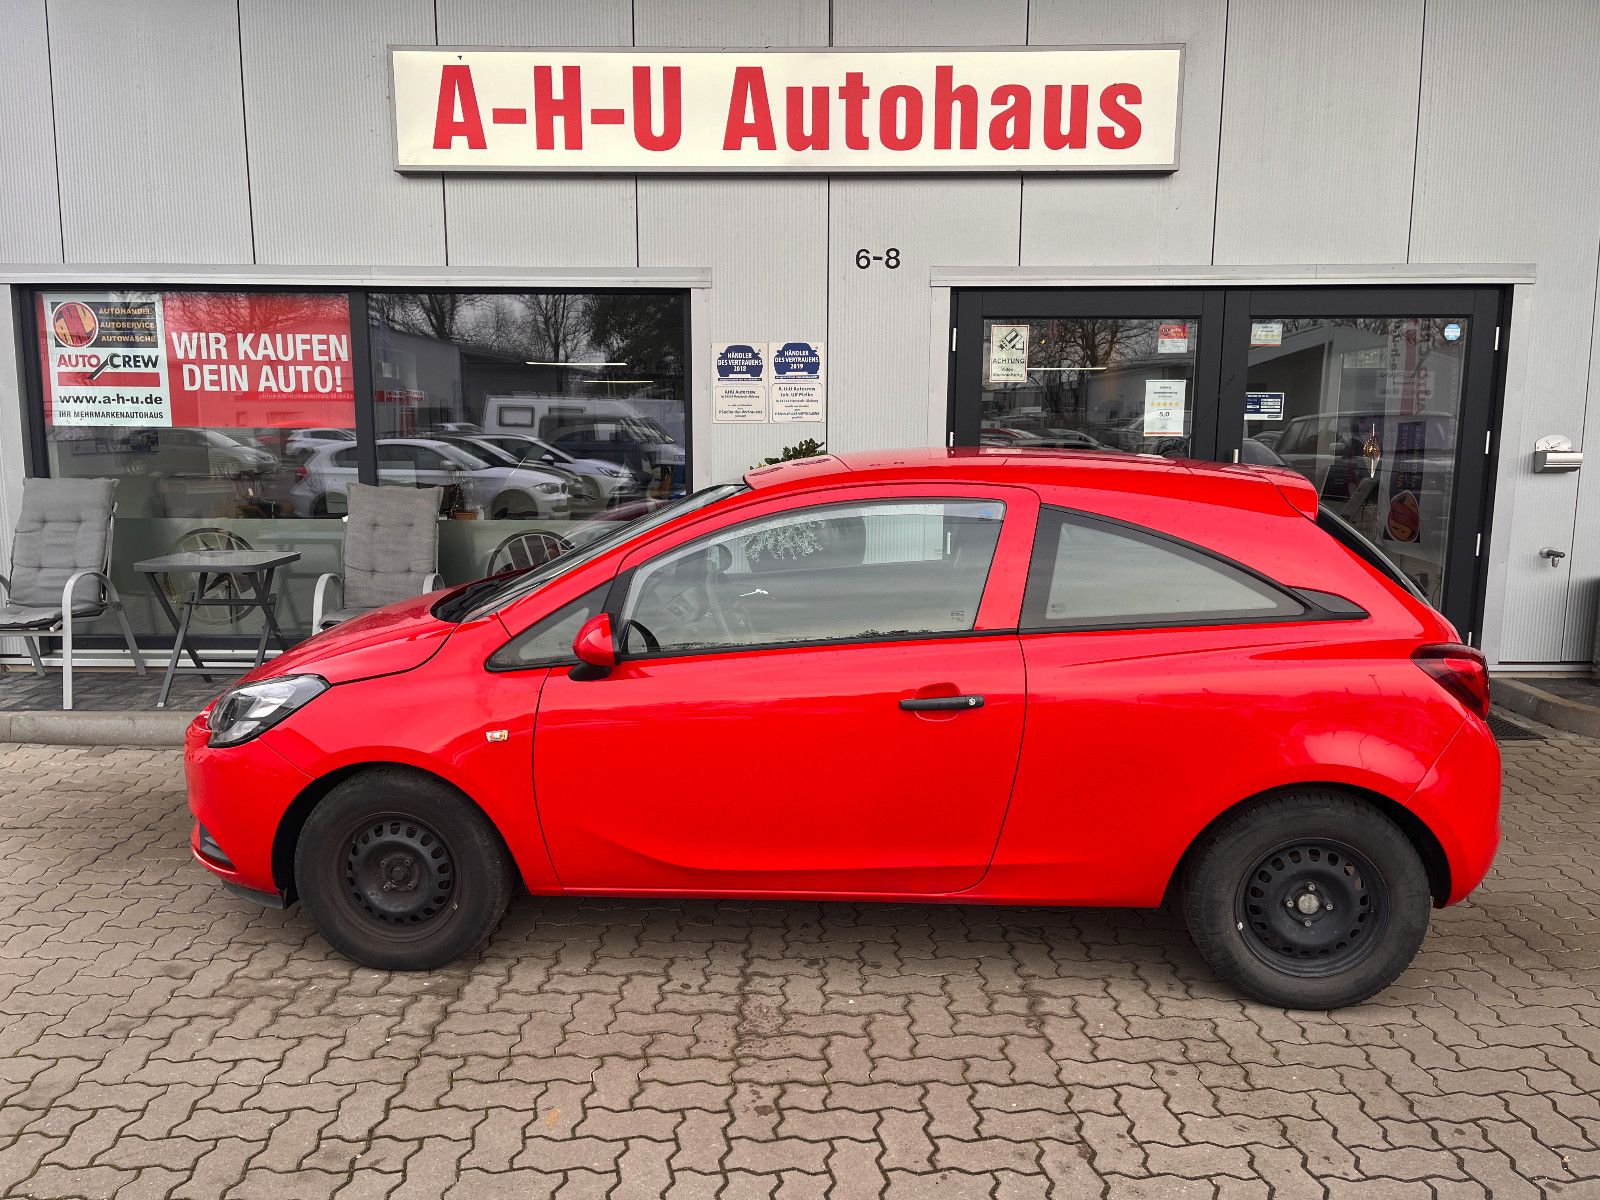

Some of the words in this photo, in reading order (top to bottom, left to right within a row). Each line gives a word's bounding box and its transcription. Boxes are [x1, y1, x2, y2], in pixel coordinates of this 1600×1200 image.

[432, 65, 682, 152] A-H-U
[723, 65, 1143, 152] Autohaus
[855, 247, 901, 270] 6-8
[99, 307, 153, 315] AUTOHANDEL
[100, 321, 156, 329] AUTOSERVICE
[171, 332, 228, 360] WIR
[236, 333, 349, 362] KAUFEN
[57, 354, 101, 368] AUTO
[182, 364, 249, 392] DEIN
[258, 365, 342, 393] AUTO!
[59, 393, 163, 405] www.a-h-u.de
[59, 410, 72, 418] IHR
[73, 410, 164, 419] MEHRMARKENAUTOHAUS
